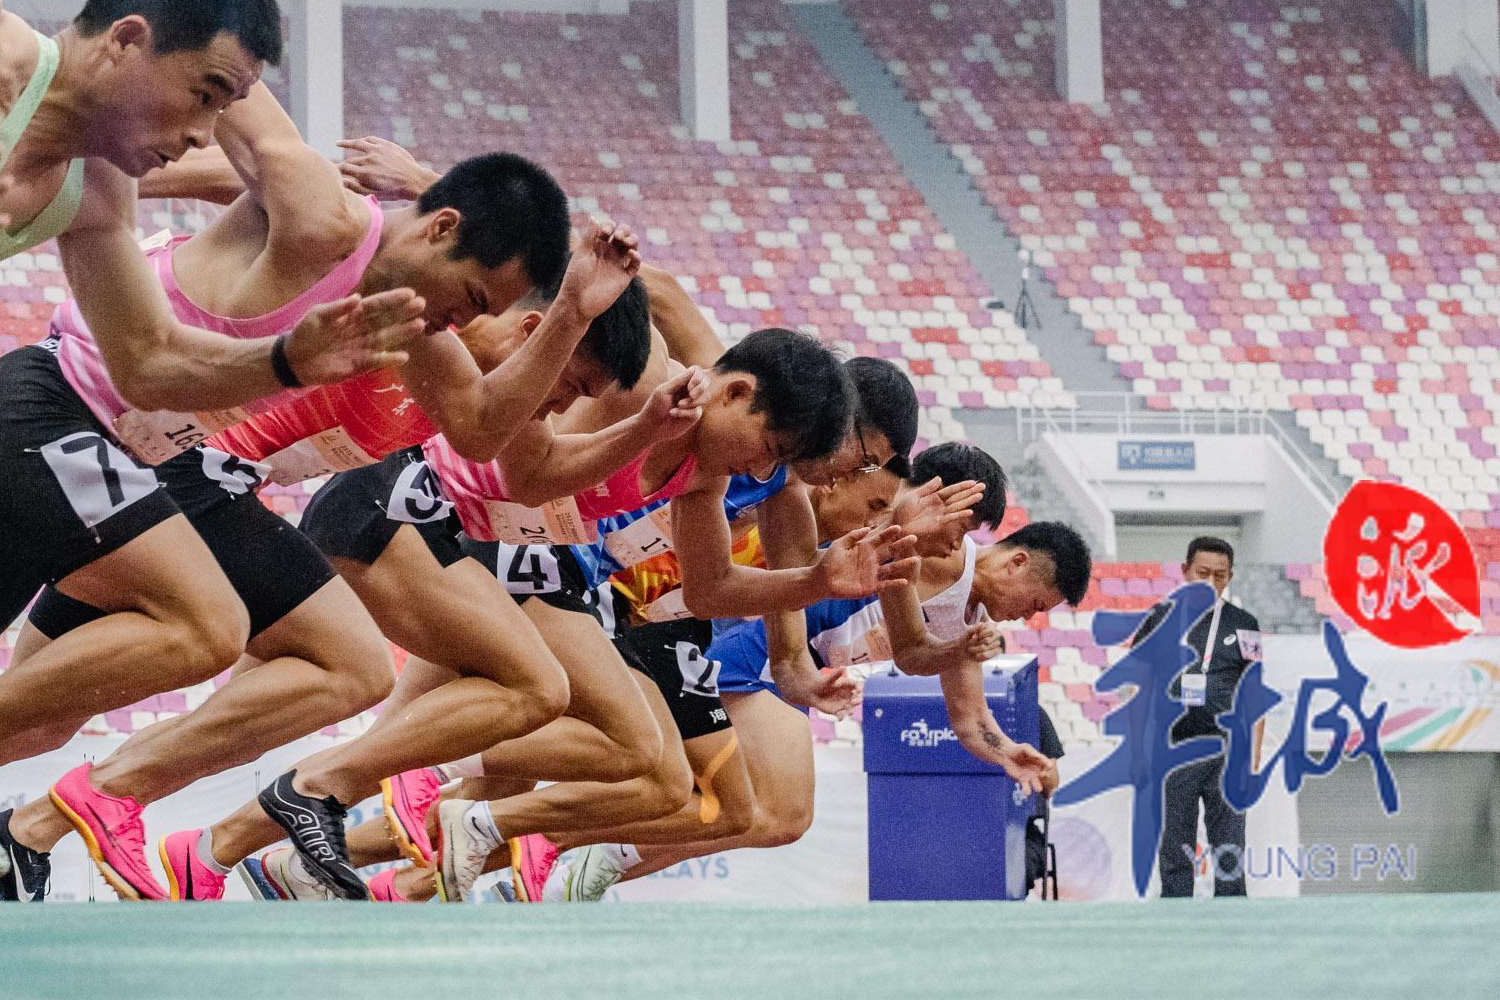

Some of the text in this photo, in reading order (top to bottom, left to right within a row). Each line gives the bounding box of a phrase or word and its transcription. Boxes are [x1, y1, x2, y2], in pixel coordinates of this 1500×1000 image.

[60, 436, 125, 507] 7
[507, 545, 548, 590] 4
[687, 647, 717, 694] 2
